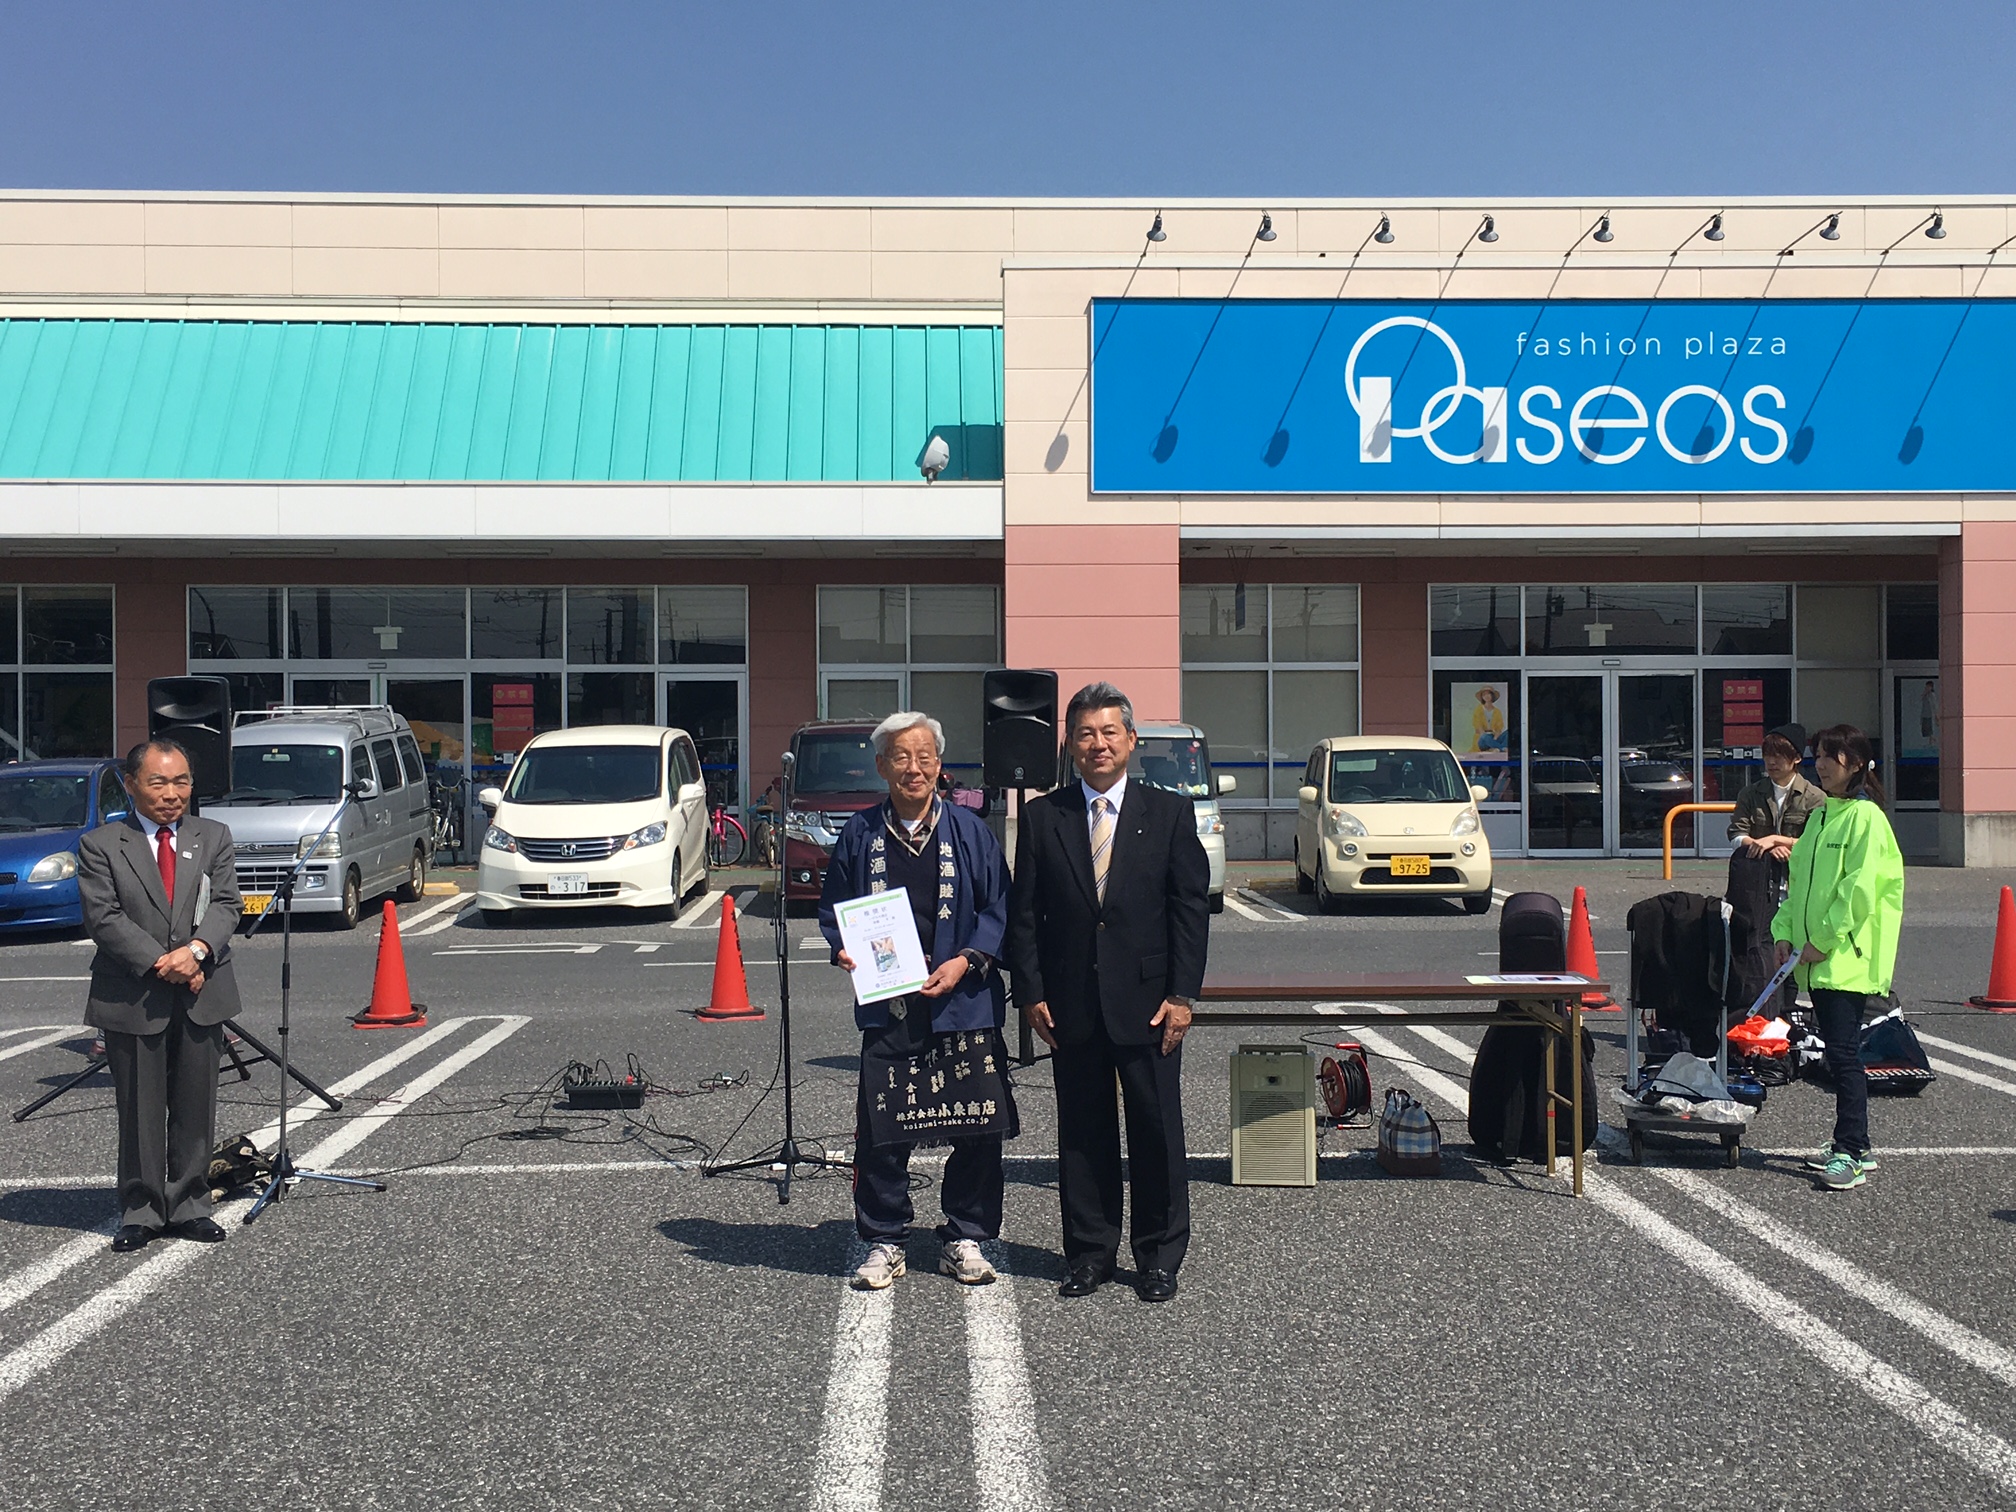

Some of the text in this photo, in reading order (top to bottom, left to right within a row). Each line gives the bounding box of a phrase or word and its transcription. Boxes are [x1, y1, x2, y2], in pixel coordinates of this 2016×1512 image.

[1517, 331, 1787, 360] fashion plaza
[1345, 316, 1788, 464] Paseos
[938, 841, 955, 920] 地酒睦会
[1399, 864, 1428, 874] 97-25
[895, 1100, 996, 1121] 株式会社小泉商店
[903, 1118, 989, 1131] koizumi-sake.co.jp
